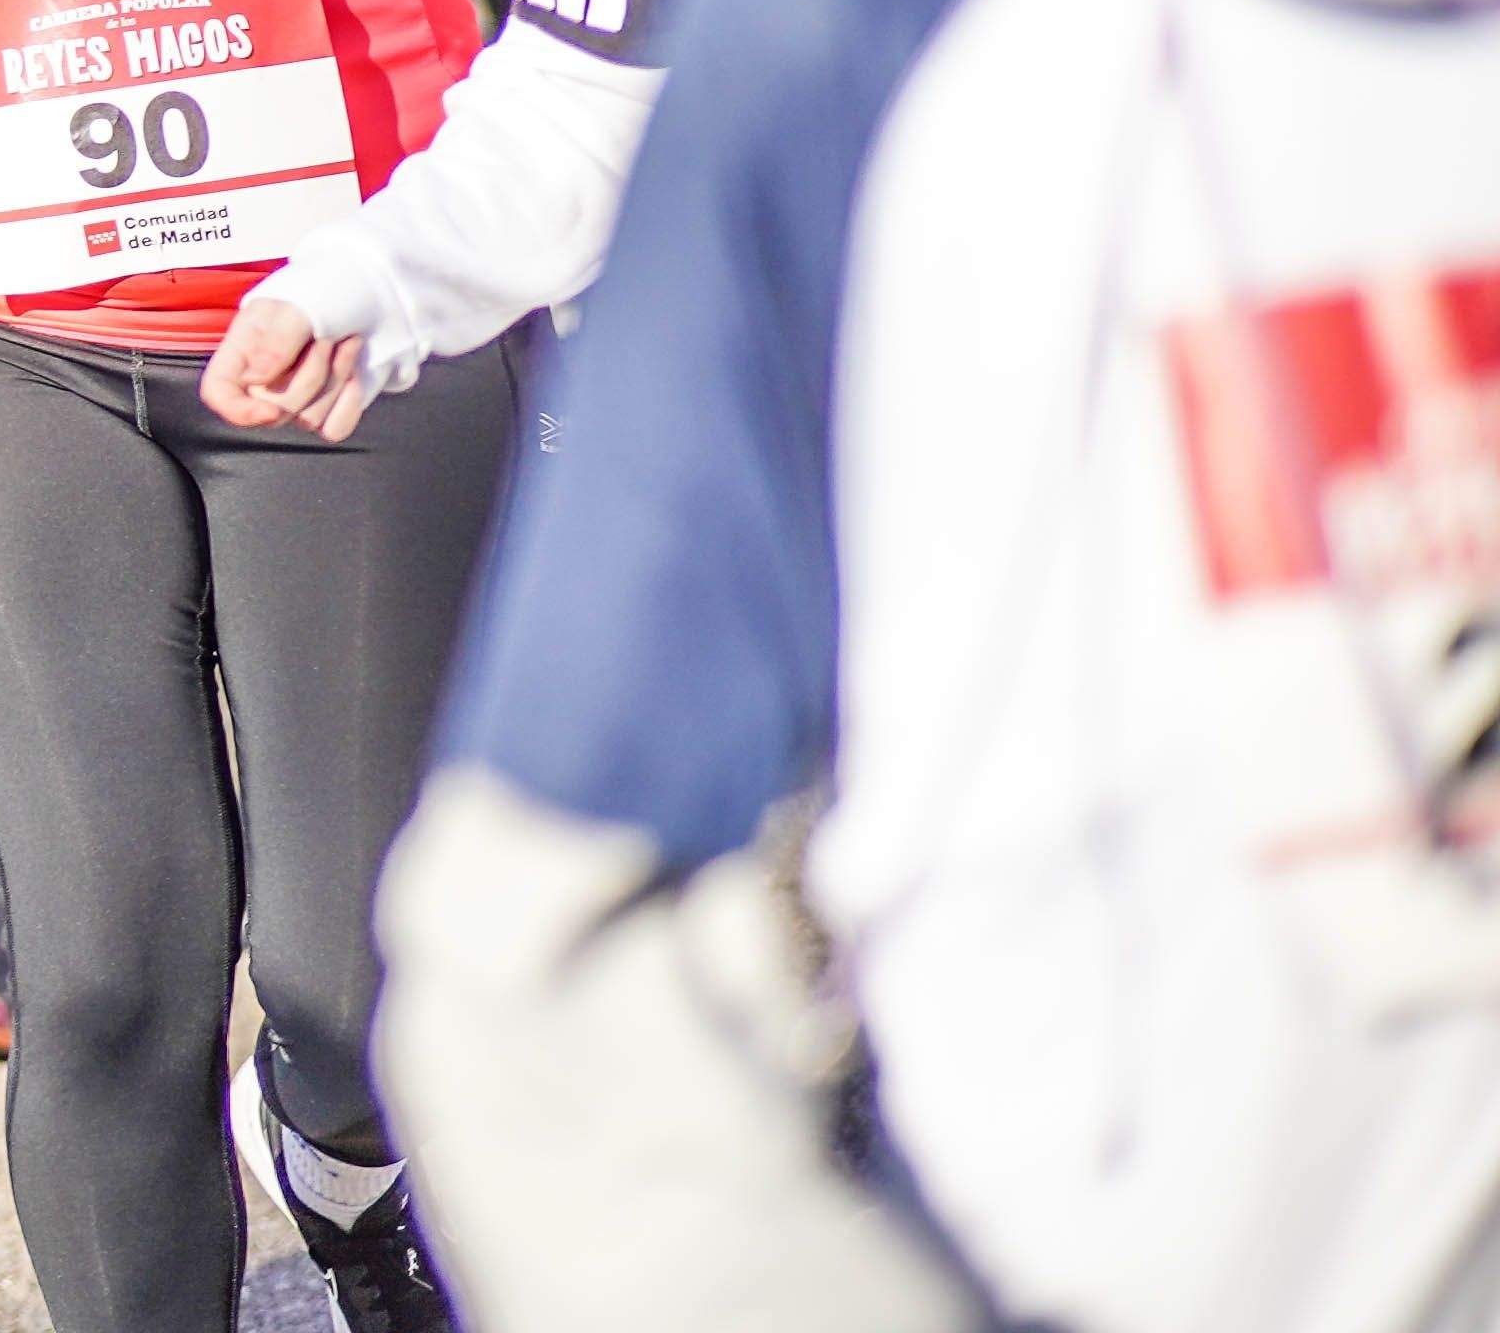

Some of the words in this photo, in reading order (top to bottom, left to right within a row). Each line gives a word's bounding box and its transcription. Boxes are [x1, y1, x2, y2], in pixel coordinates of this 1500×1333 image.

[30, 2, 118, 32] CARRERA
[1, 36, 114, 94] REYES
[123, 14, 254, 78] MAGOS
[69, 90, 210, 188] 90
[124, 205, 229, 229] Comunidad
[128, 235, 152, 249] de
[160, 225, 232, 245] Madrid
